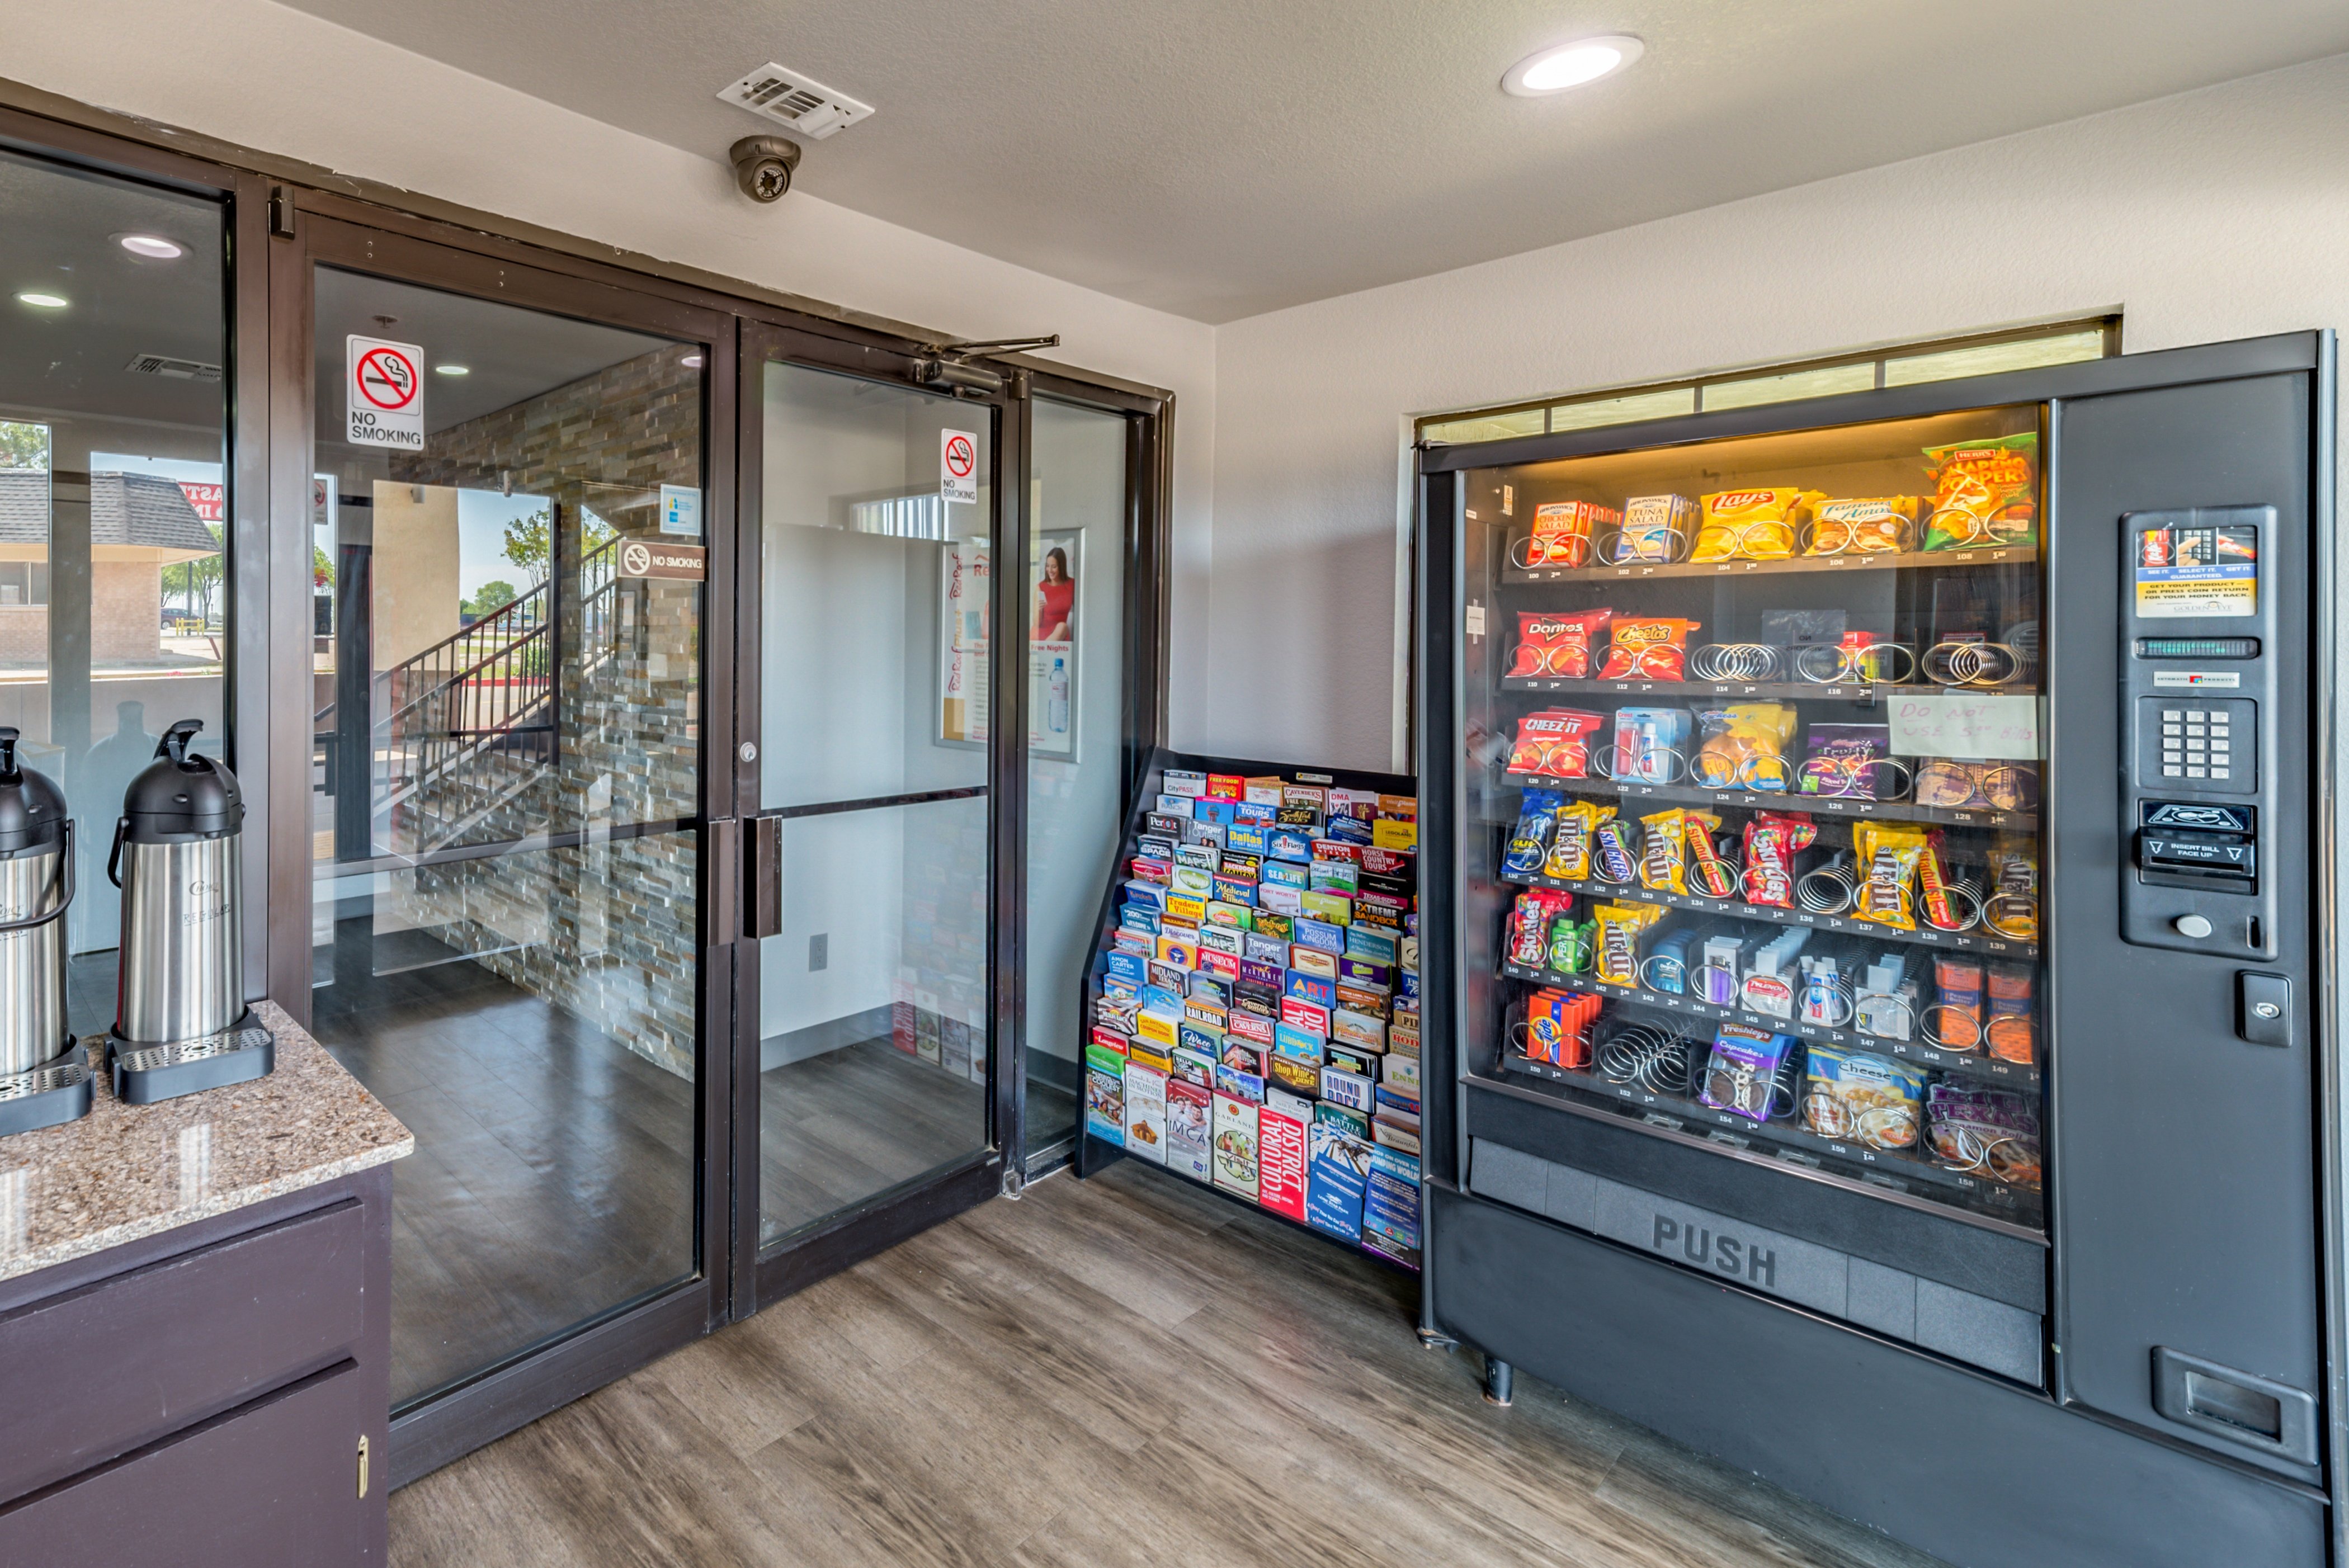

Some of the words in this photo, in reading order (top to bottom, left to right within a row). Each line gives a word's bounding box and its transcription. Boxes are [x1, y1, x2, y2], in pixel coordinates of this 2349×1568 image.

[352, 412, 375, 425] NO
[352, 426, 421, 445] SMOKING
[944, 479, 955, 488] NO
[944, 488, 975, 500] SMOKING
[1713, 492, 1771, 510] Lay's
[1820, 500, 1892, 515] Famous
[1844, 507, 1892, 520] Amos
[653, 556, 665, 565] NO
[667, 558, 702, 568] SMOKING
[1529, 623, 1583, 634] Doritos
[1616, 625, 1671, 643] Cheetos
[1047, 645, 1069, 653] Nights
[1900, 703, 1930, 717] DO
[1946, 705, 1996, 718] NOT
[1904, 726, 1944, 736] USE
[1168, 785, 1194, 794] CityPASS
[1241, 808, 1270, 818] TOURS
[1193, 821, 1223, 834] Tanger
[1192, 828, 1221, 842] Outlets
[1230, 831, 1262, 844] Dallas
[1140, 848, 1171, 857] SPACE
[1316, 843, 1350, 852] DENTON
[1178, 856, 1207, 866] MAPS
[1363, 855, 1395, 865] COUNTRY
[1365, 862, 1387, 871] TOURS
[1224, 862, 1256, 872] BACKDOOR
[1268, 870, 1282, 879] SEA
[1216, 881, 1249, 897] Medieval
[1168, 897, 1199, 910] Traders
[1223, 893, 1244, 904] Times
[1174, 906, 1202, 918] Village
[1355, 903, 1397, 917] EXTREME
[1355, 911, 1398, 926] SANDBOX
[1164, 926, 1195, 939] Discover
[1305, 928, 1337, 941] POSSUM
[1203, 937, 1234, 951] MAPS
[1248, 938, 1281, 952] Tanger
[1302, 934, 1337, 947] KINGDOM
[1349, 938, 1390, 952] HENDERSON
[1248, 946, 1282, 961] Outlets
[1111, 961, 1134, 970] CARTER
[1202, 953, 1235, 969] MUSEUM
[1152, 965, 1180, 981] MIDLAND
[1294, 979, 1329, 998] ART
[1750, 981, 1783, 991] TYLENOL
[1949, 993, 1973, 1001] Peanut
[1243, 999, 1267, 1009] Caverns
[1186, 1007, 1222, 1027] RAILROAD
[1234, 1023, 1267, 1033] CAVERNS
[1723, 1024, 1771, 1039] Freshley's
[1098, 1036, 1124, 1050] Longview
[1183, 1030, 1211, 1048] Waco
[1719, 1040, 1763, 1058] Cupcakes
[1727, 1051, 1755, 1062] Chocolate
[1839, 1063, 1891, 1080] Cheese
[1327, 1075, 1361, 1098] ROUND
[1935, 1087, 2026, 1113] BIG
[1215, 1112, 1253, 1130] GARLAND
[1331, 1116, 1361, 1132] BATTLE
[1928, 1103, 2039, 1135] TEXAS
[2001, 1130, 2023, 1139] Roll
[1261, 1118, 1282, 1192] CULTURAL
[1282, 1122, 1301, 1192] DISTRICT
[1958, 1178, 1974, 1187] 158
[1653, 1213, 1775, 1287] PUSH
